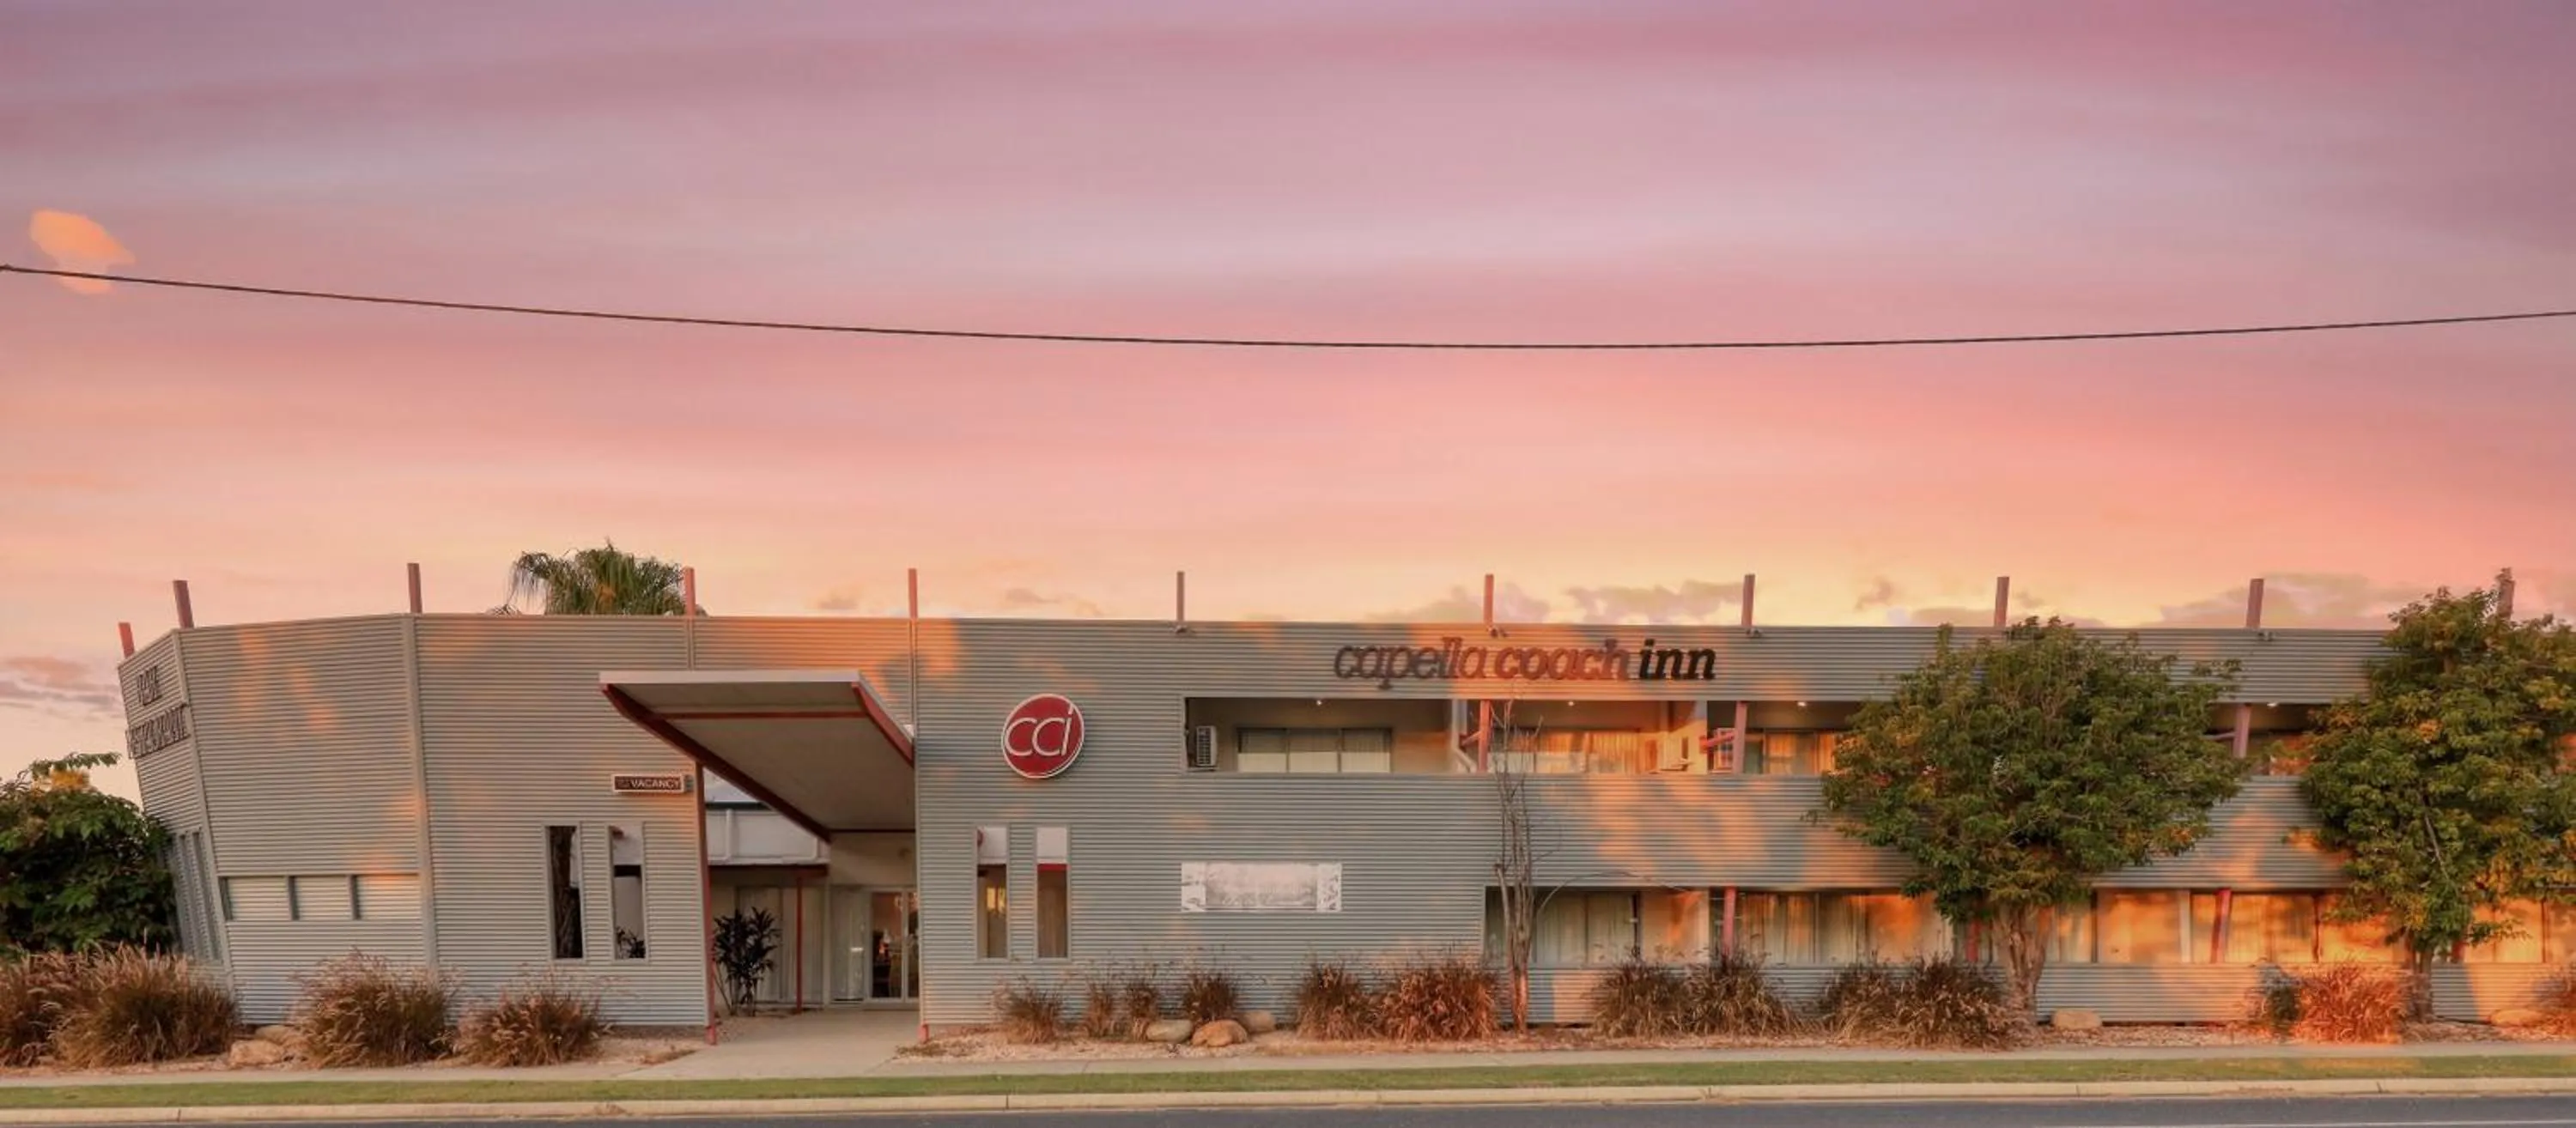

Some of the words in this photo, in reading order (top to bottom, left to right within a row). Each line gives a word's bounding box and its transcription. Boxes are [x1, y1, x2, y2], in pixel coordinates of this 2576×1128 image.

[1334, 637, 1487, 689] capella
[1494, 639, 1631, 680] coach
[1638, 639, 1716, 680] inn
[1005, 704, 1074, 755] cci
[631, 778, 679, 788] VACANCY
